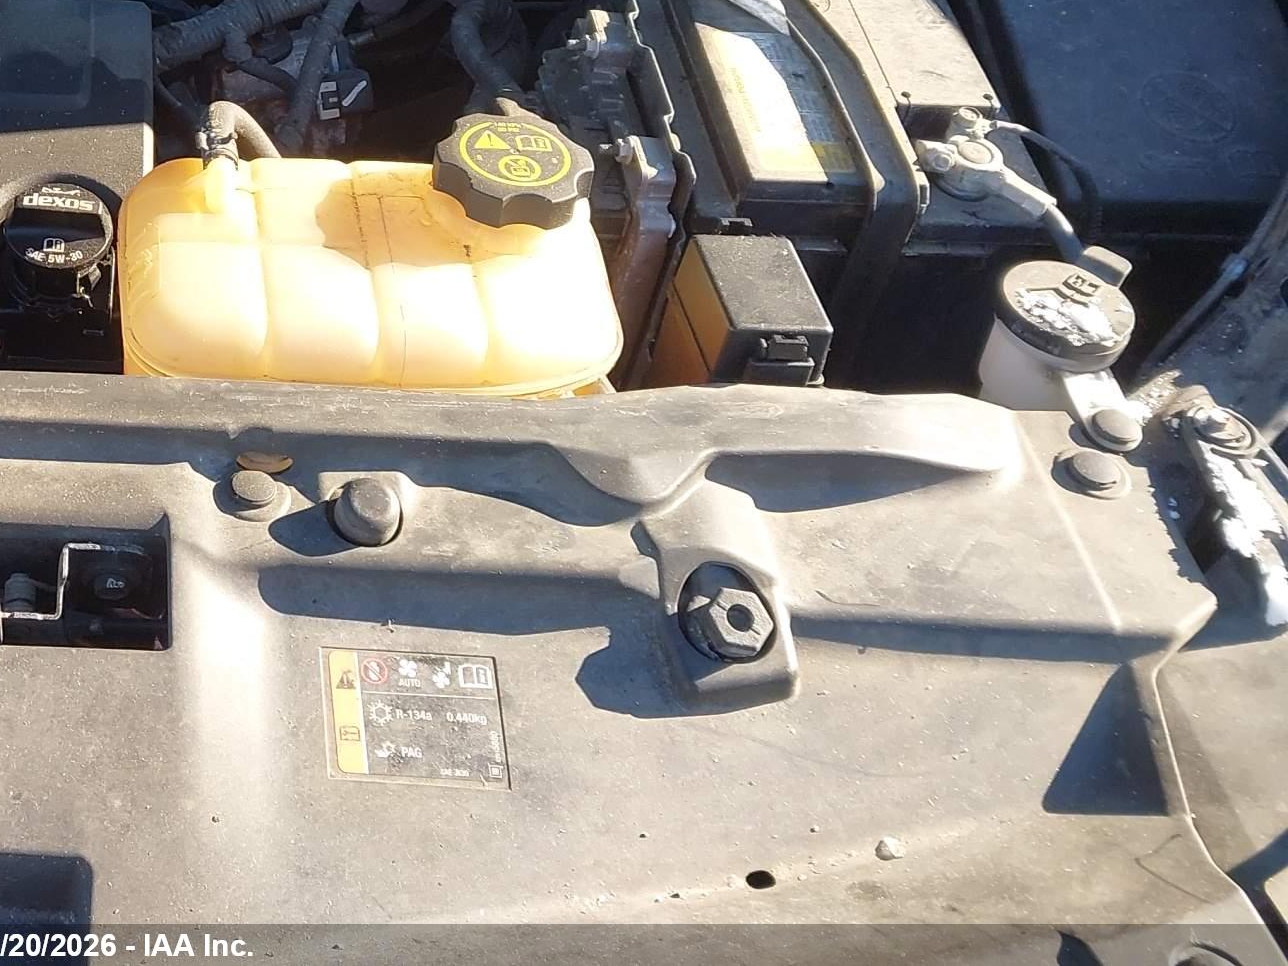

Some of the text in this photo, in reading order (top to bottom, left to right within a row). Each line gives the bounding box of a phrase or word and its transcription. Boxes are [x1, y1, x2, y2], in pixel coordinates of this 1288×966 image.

[23, 192, 96, 211] dexos
[25, 247, 83, 263] SAE 5W-30
[398, 678, 421, 688] AUTO
[395, 709, 433, 721] R-134a
[400, 746, 423, 758] PAG
